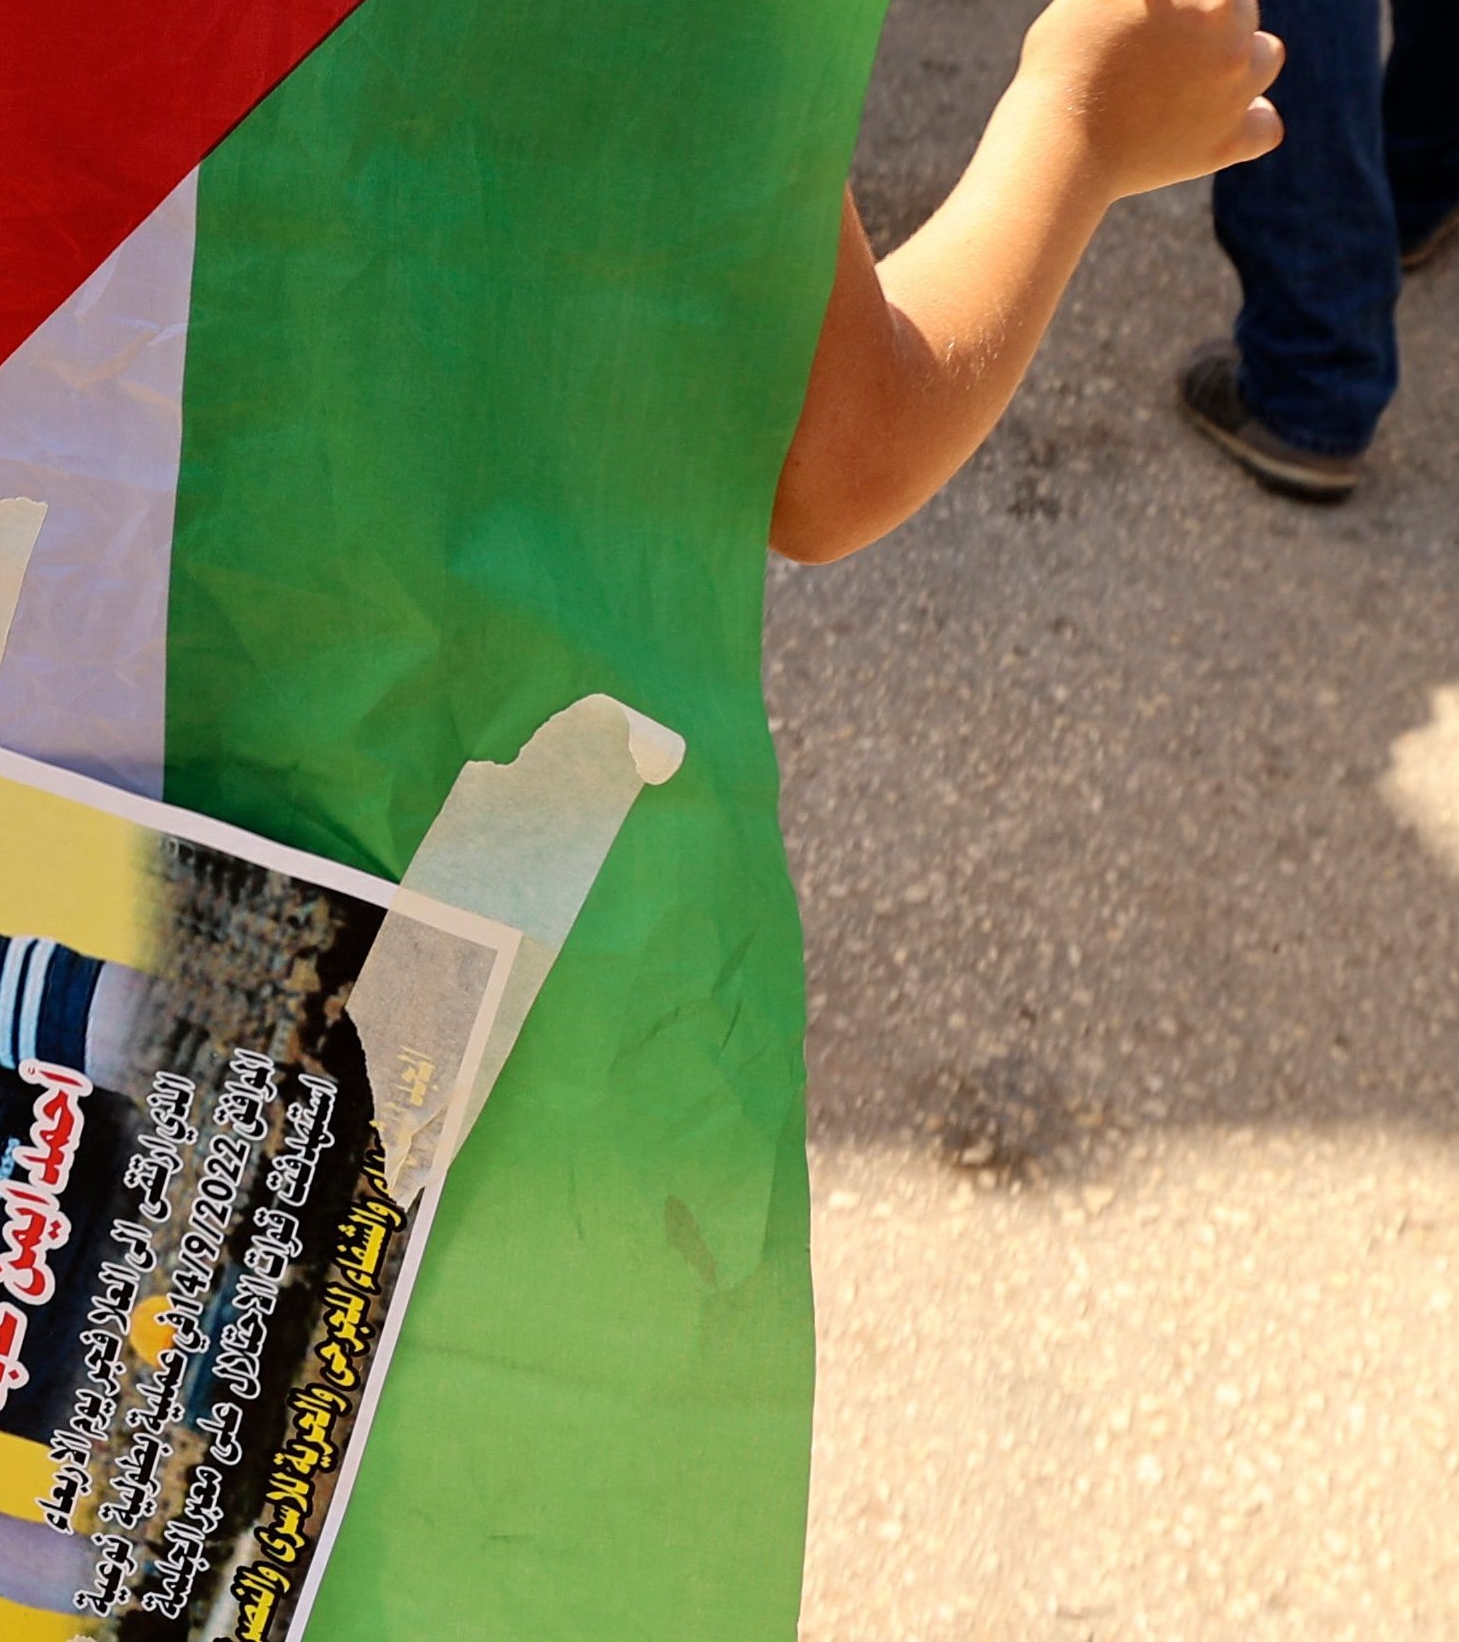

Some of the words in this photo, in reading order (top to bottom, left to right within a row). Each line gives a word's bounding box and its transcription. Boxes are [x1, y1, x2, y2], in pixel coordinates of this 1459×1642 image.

[23, 1068, 82, 1187] أحمد
[147, 1071, 197, 1144] الذي
[213, 1048, 276, 1139] الموافق
[124, 1135, 182, 1221] ارتقى
[266, 1074, 336, 1205] استهدفت
[111, 1219, 156, 1271] الى
[244, 1207, 301, 1281] قوات
[340, 1198, 403, 1290] والشفاء
[88, 1262, 139, 1333] العلا
[212, 1275, 277, 1398] الاحتلال
[318, 1284, 367, 1389] للجرحى
[80, 1329, 126, 1395] فجر
[125, 1349, 186, 1434] عملية
[70, 1389, 115, 1440] يوم
[197, 1403, 241, 1464] على
[271, 1385, 349, 1476] والحرية
[37, 1430, 92, 1534] الاربعاء
[98, 1433, 173, 1528] بطولية
[185, 1466, 222, 1532] معبر
[266, 1469, 312, 1564] للاسرى
[72, 1532, 137, 1616] نوعية
[142, 1521, 208, 1617] الجلمة
[234, 1564, 292, 1642] والنص
